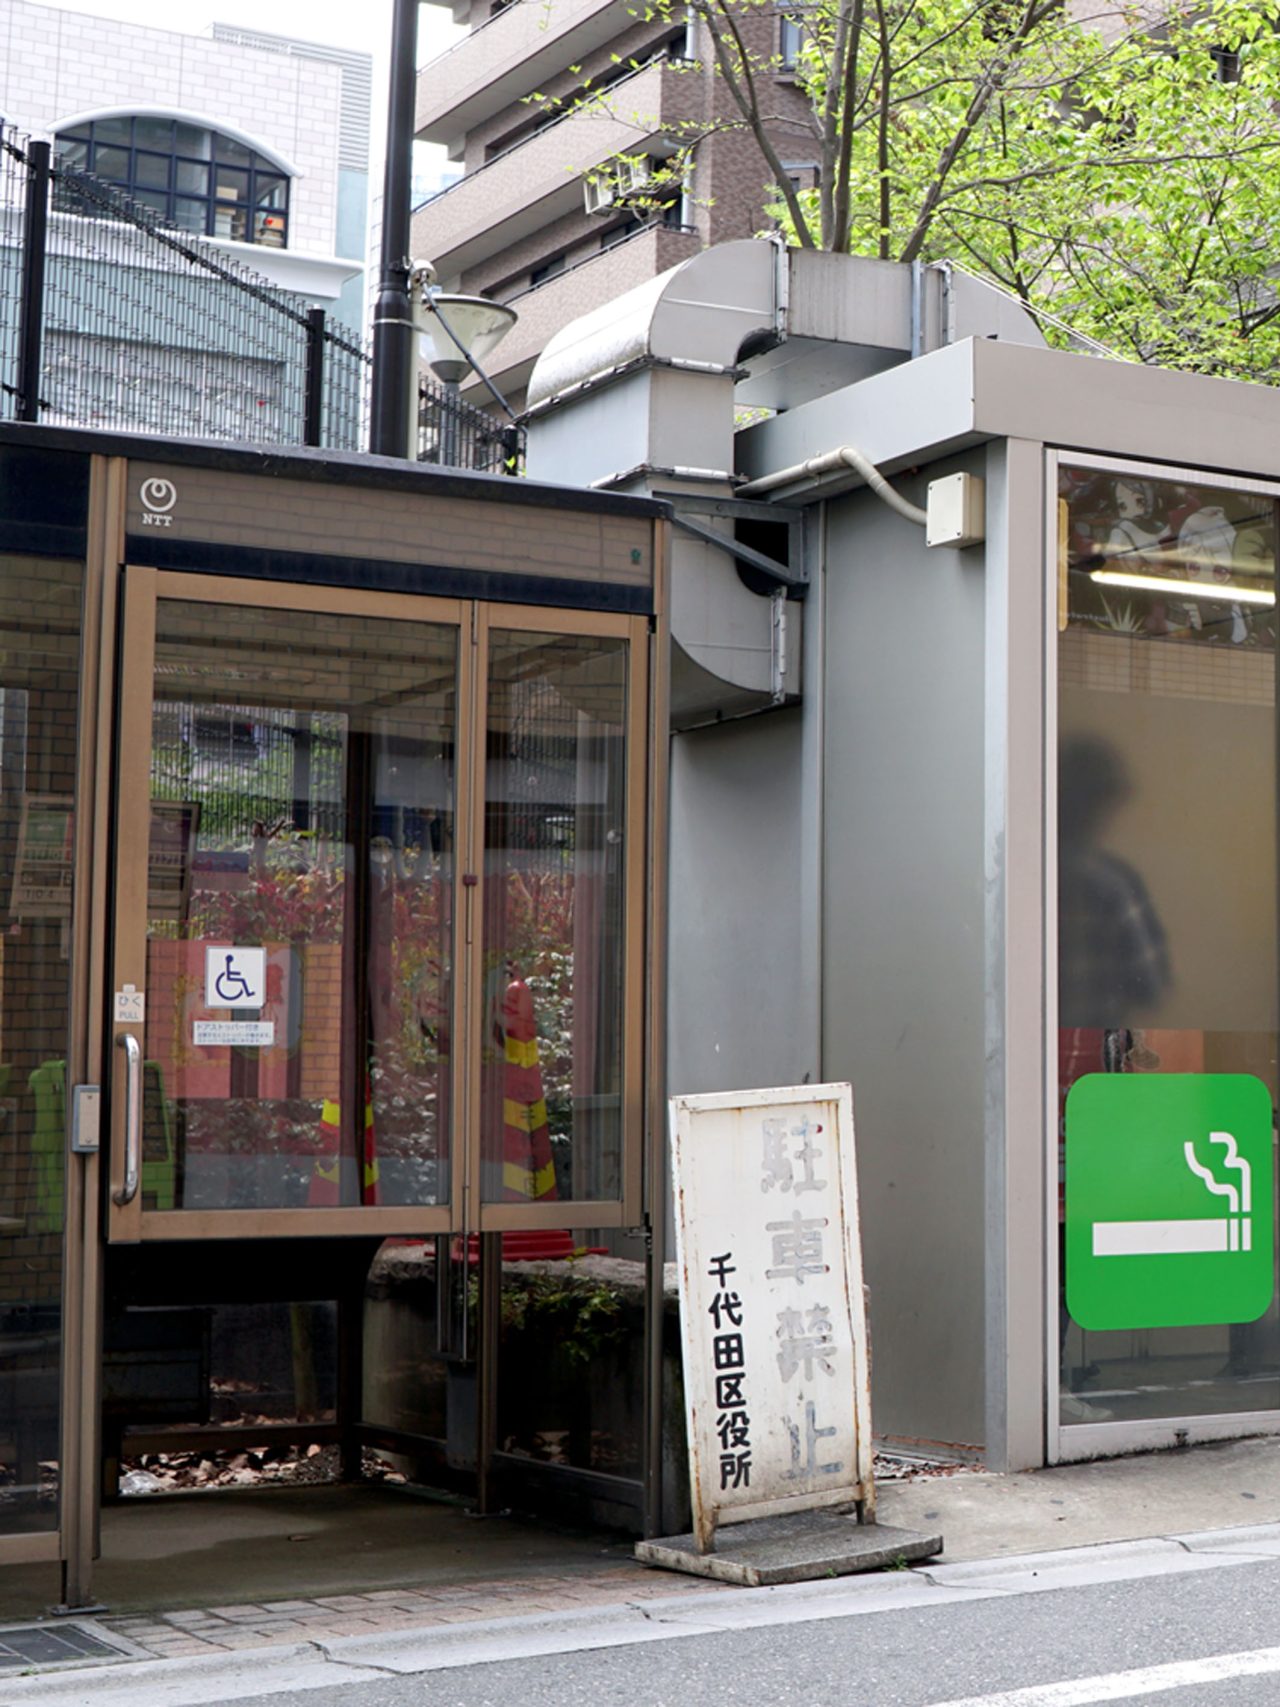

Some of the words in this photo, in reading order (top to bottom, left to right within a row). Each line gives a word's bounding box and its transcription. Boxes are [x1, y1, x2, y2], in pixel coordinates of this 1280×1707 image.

[142, 513, 172, 526] NTT
[118, 995, 141, 1006] ひく
[119, 1010, 139, 1019] PULL
[761, 1114, 843, 1481] 駐車禁止
[707, 1252, 752, 1490] 千代田区役所
